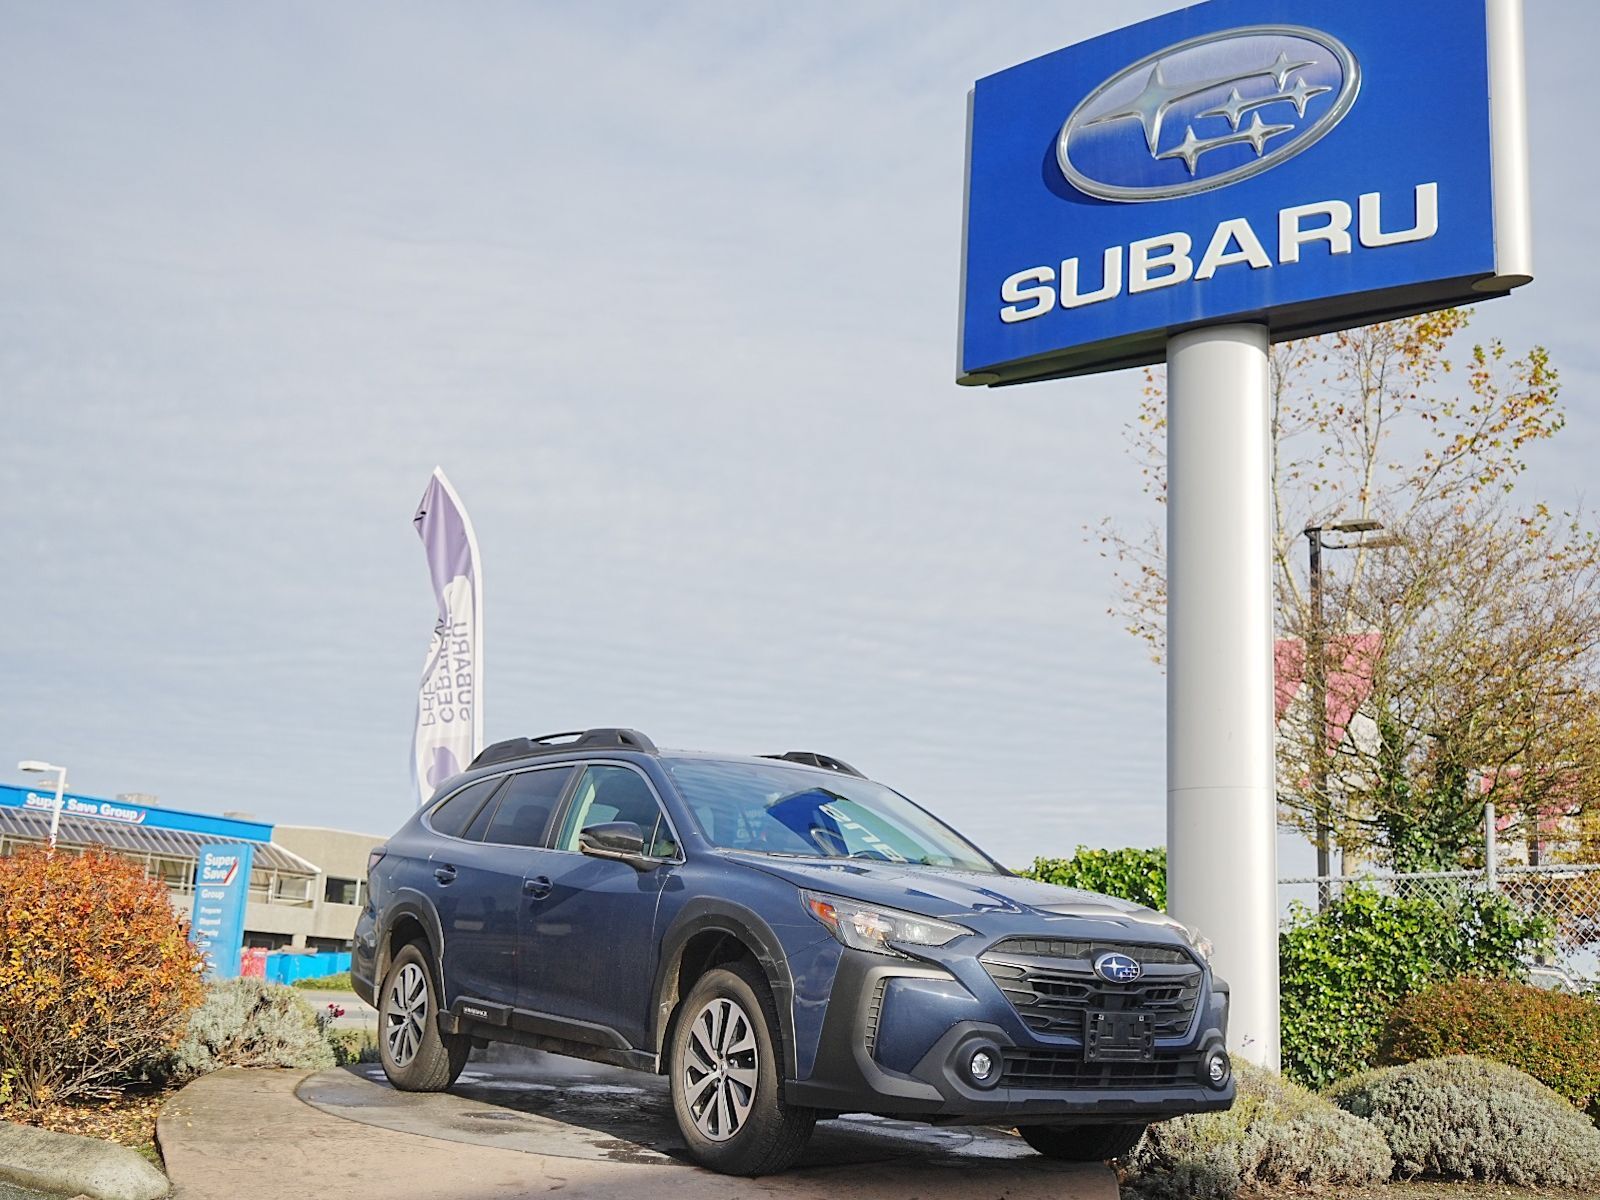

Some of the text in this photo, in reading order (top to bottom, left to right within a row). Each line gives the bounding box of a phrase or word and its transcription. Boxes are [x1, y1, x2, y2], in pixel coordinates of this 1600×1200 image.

[1000, 182, 1438, 324] SUBARU
[67, 798, 98, 814] Save
[100, 803, 138, 820] Group
[204, 852, 236, 868] Super
[202, 867, 227, 880] Save
[201, 888, 225, 900] Group
